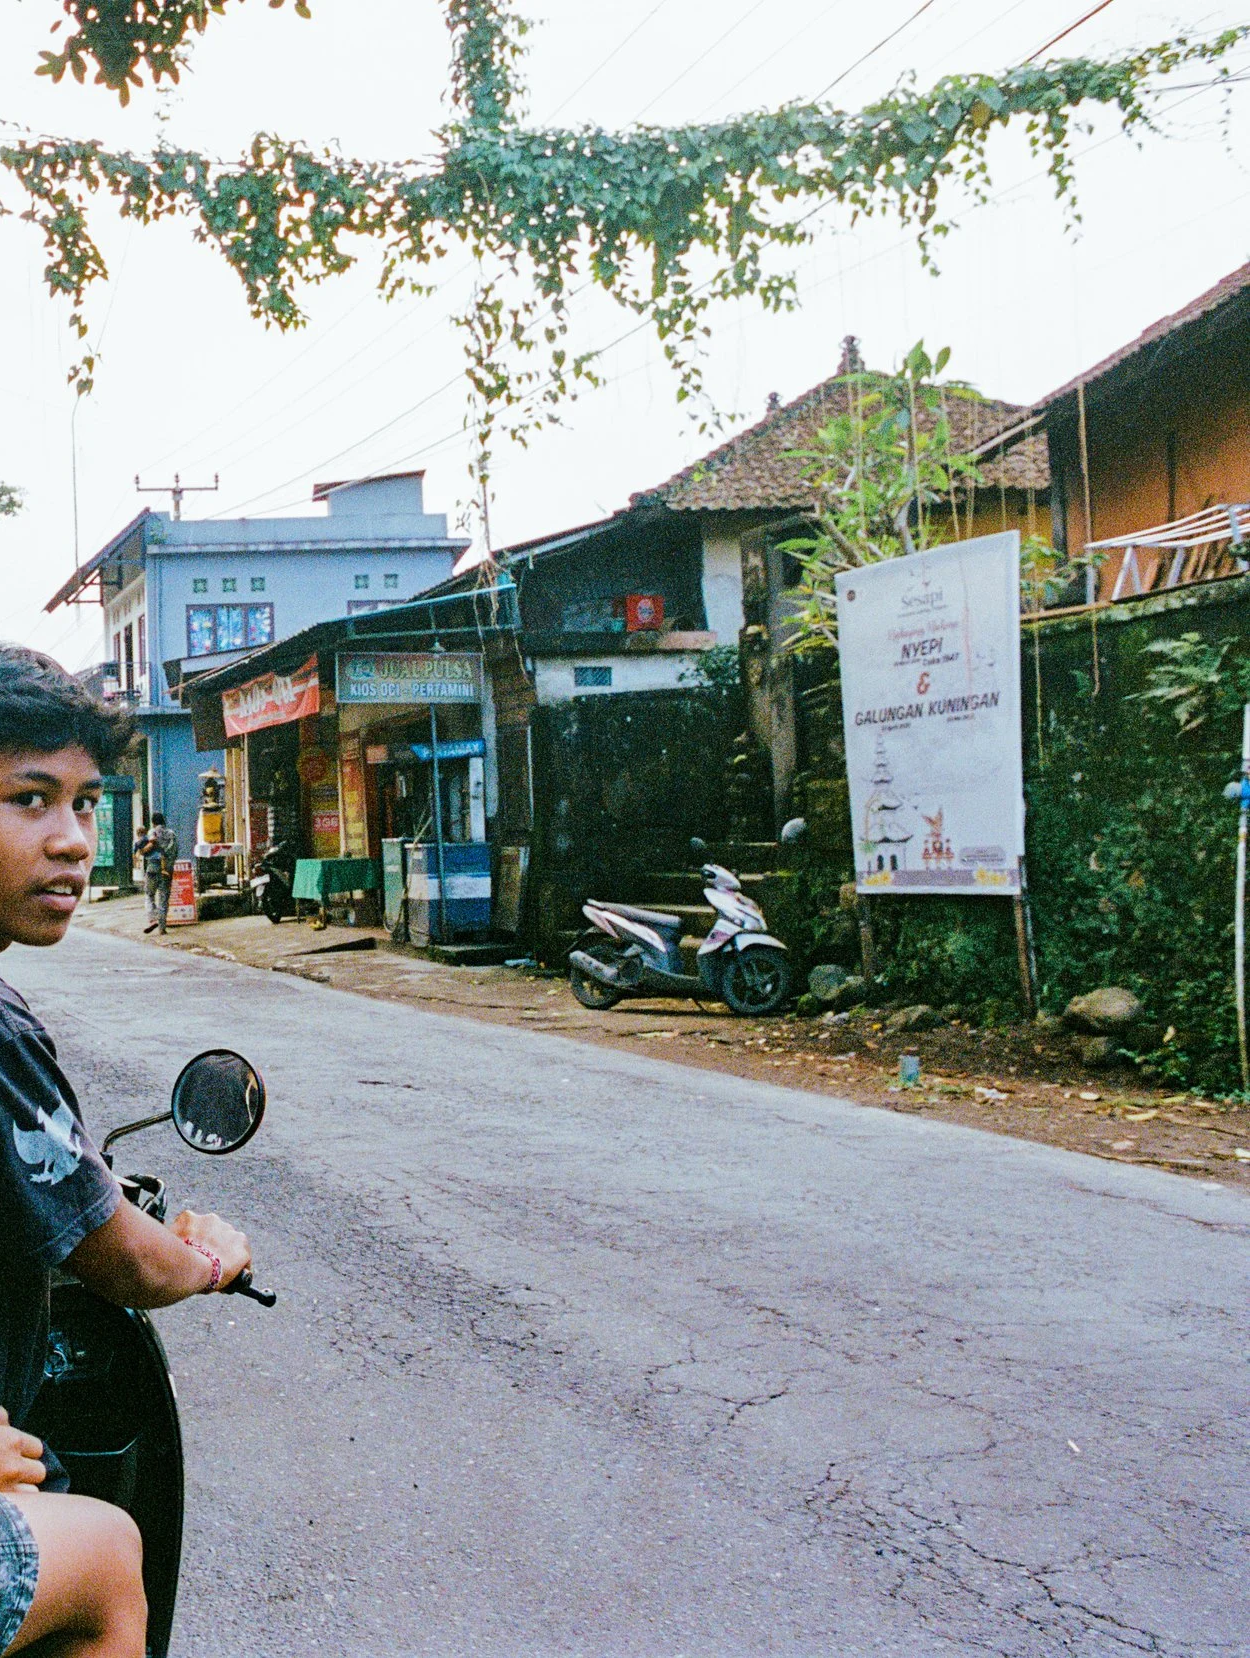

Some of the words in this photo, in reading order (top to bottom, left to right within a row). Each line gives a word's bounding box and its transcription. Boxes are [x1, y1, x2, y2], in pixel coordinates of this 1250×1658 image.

[901, 637, 944, 659] NYEPI
[380, 659, 420, 679] JUAL
[425, 659, 472, 679] PULSA
[350, 682, 377, 697] KIOS
[412, 682, 474, 697] PERTAMINI
[916, 671, 931, 695] &
[854, 702, 924, 726] GALUNGAN
[928, 691, 1001, 716] KUNINGAN
